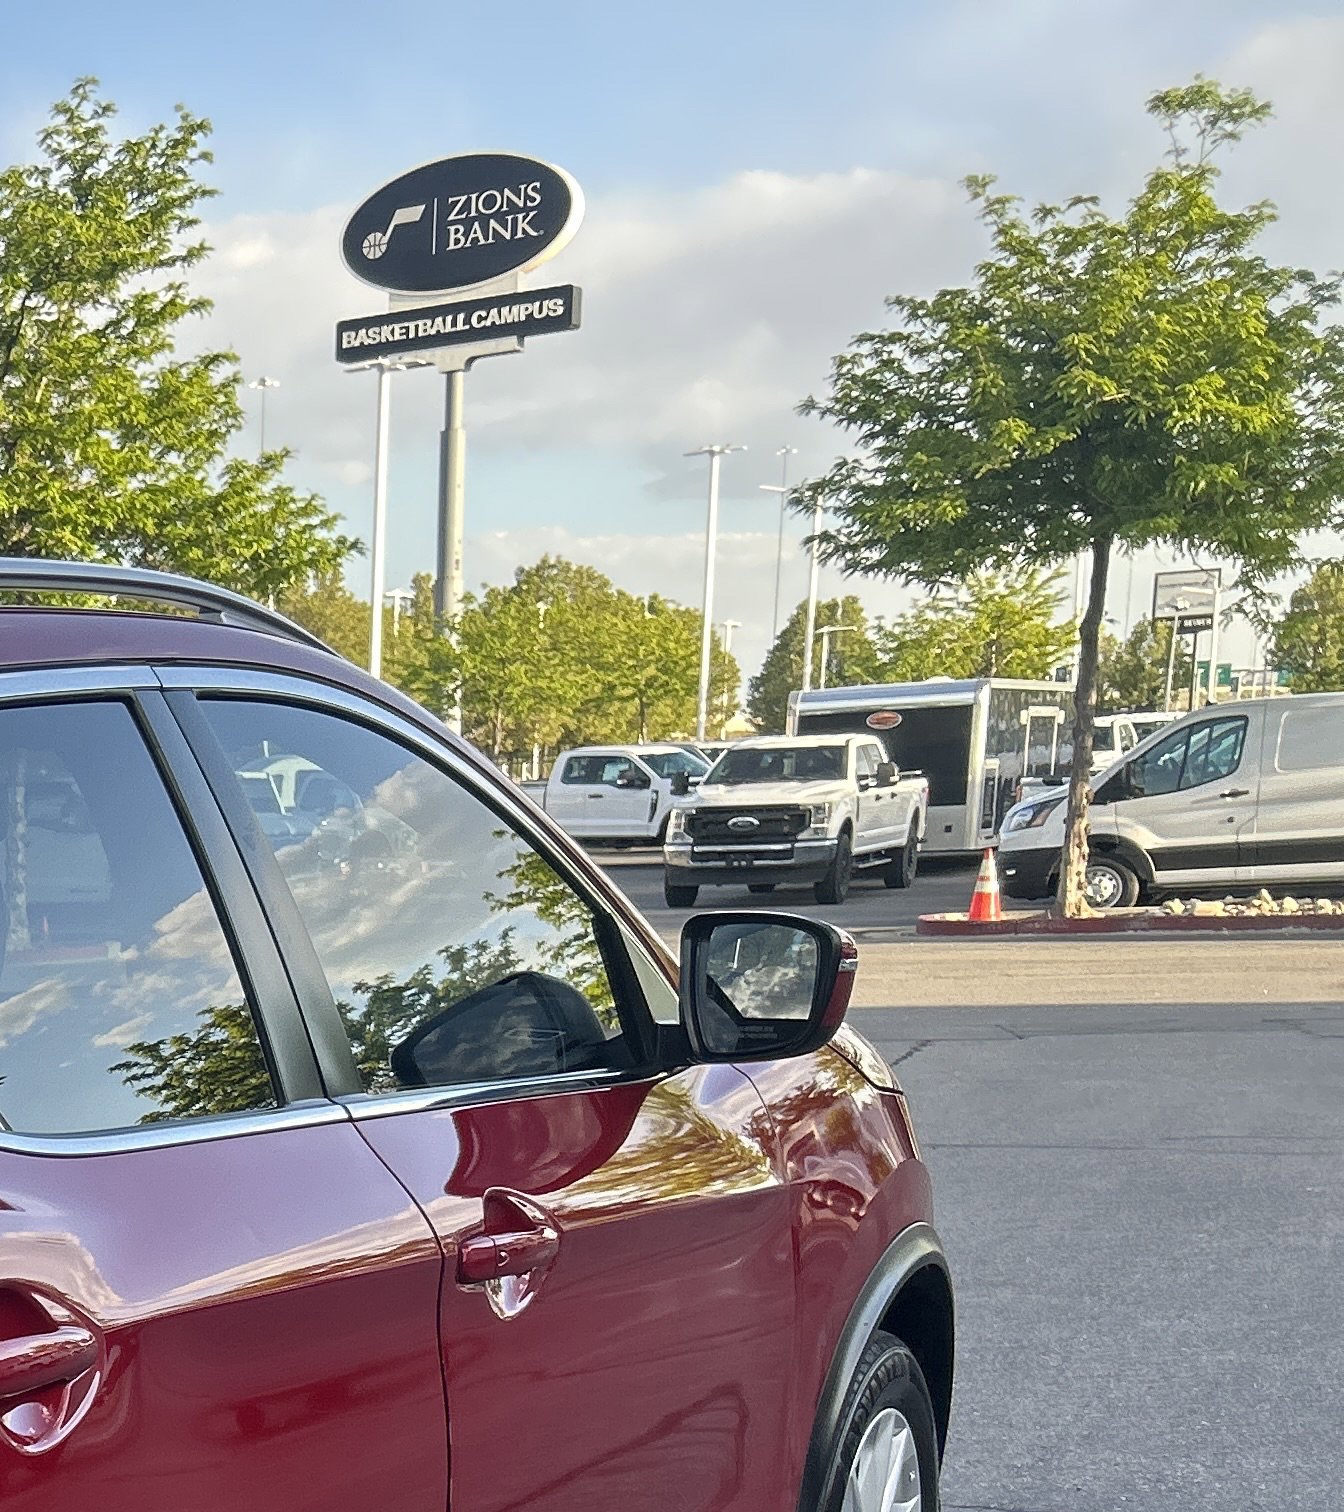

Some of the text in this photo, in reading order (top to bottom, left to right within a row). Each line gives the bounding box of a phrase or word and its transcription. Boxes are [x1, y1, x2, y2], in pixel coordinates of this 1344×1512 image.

[446, 181, 542, 222] ZIONS
[446, 210, 539, 251] BANK
[341, 297, 565, 349] BASKETBALL CAMPUS
